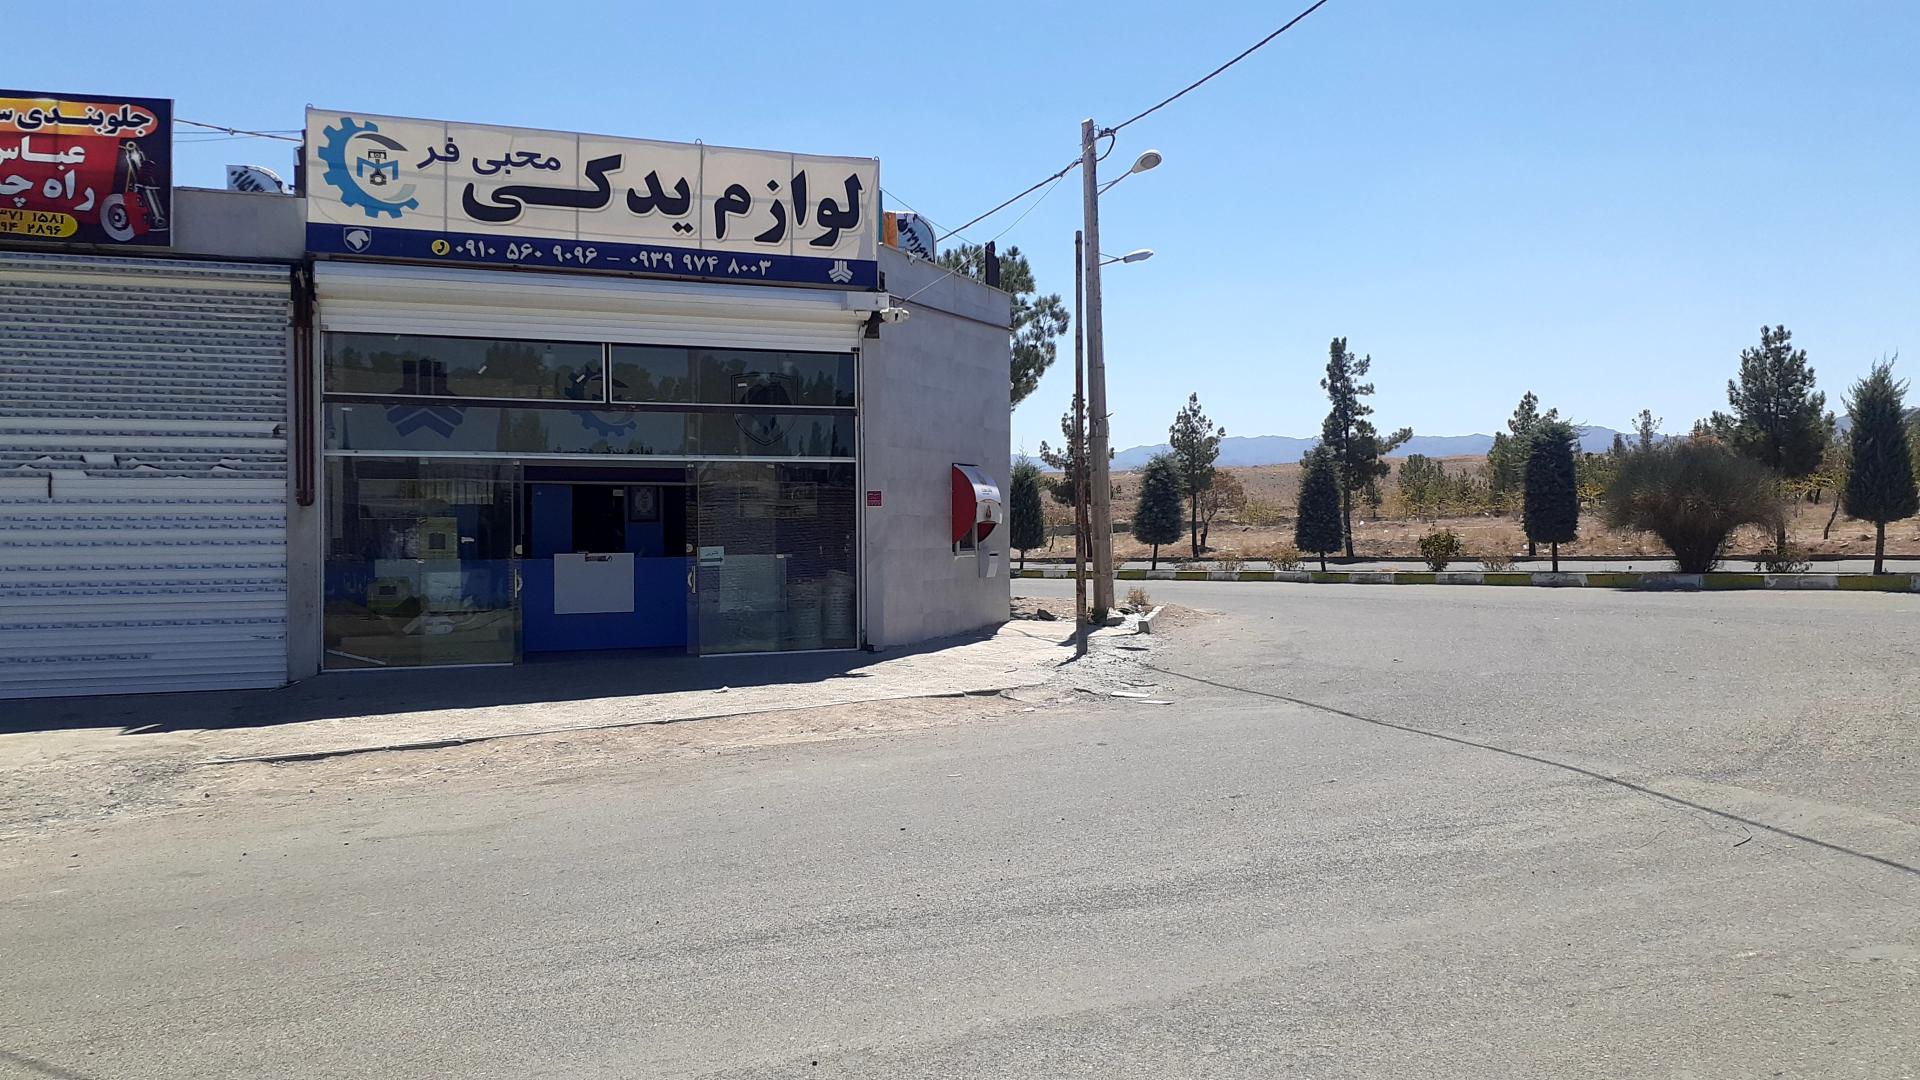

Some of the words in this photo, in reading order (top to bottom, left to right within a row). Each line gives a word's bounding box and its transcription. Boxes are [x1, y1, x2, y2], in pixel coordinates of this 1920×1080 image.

[16, 104, 153, 136] جلوبندی
[416, 137, 460, 169] فر
[472, 149, 561, 175] محبی
[42, 169, 96, 212] راه
[462, 153, 694, 233] یدکی
[714, 169, 863, 246] لوازم
[33, 212, 65, 225] ۱۵۸۱
[455, 239, 496, 257] ۰۹۱۰
[506, 242, 543, 260] ۵۶۰
[552, 245, 598, 264] ۹۰۹۶
[630, 250, 674, 270] ۰۹۳۹
[683, 254, 719, 273] ۹۷۴
[728, 258, 772, 277] ۸۰۰۳
